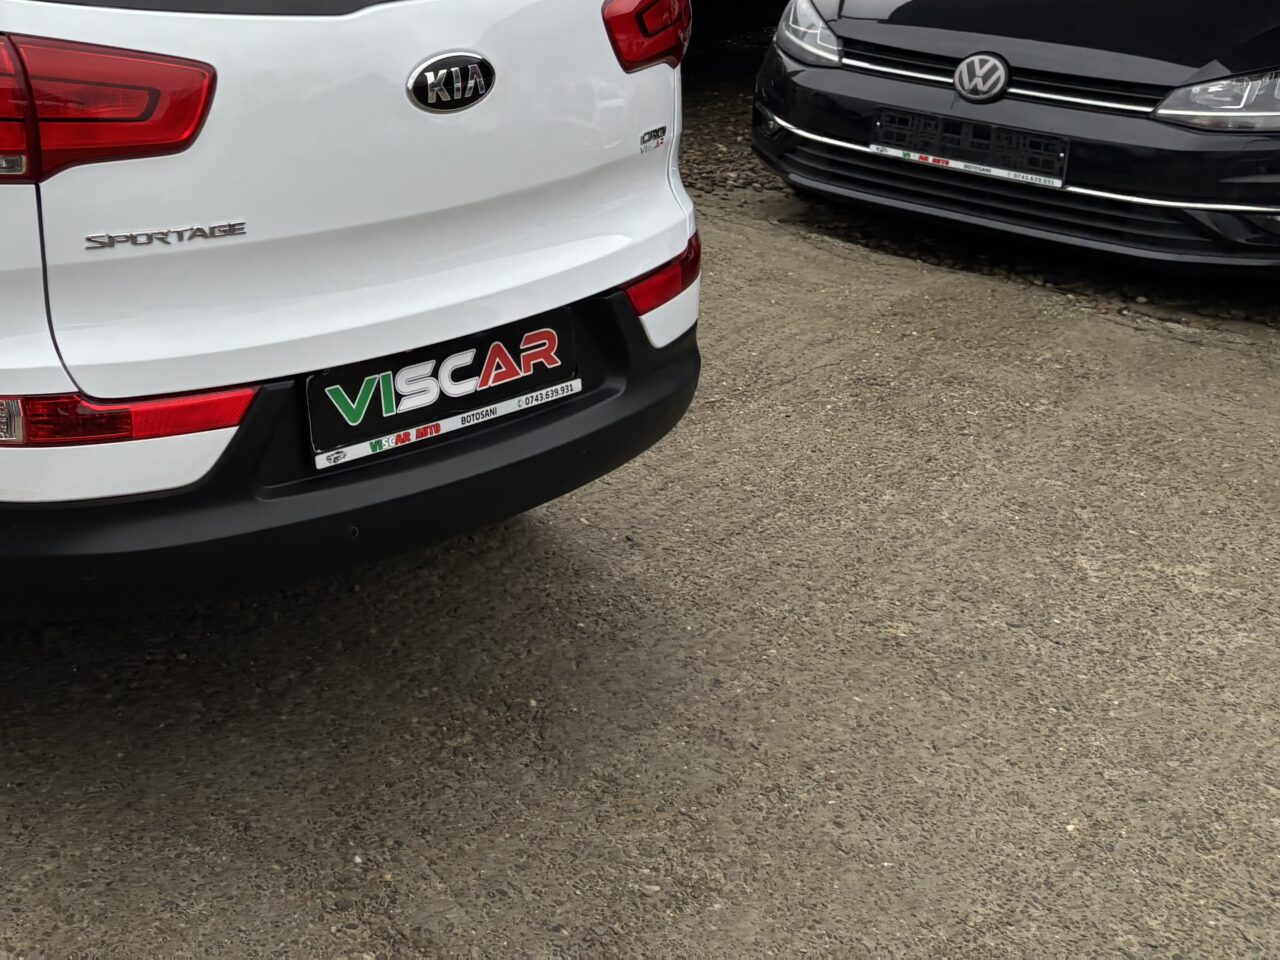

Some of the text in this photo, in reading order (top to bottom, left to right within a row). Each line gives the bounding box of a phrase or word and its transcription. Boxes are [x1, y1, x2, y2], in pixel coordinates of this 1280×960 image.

[424, 64, 485, 103] KIA
[85, 221, 247, 250] SPORTAGE
[324, 328, 561, 427] VISCAR
[415, 422, 441, 440] AUTO
[460, 406, 498, 426] BOTOSANI
[524, 383, 574, 406] 0743.639.931
